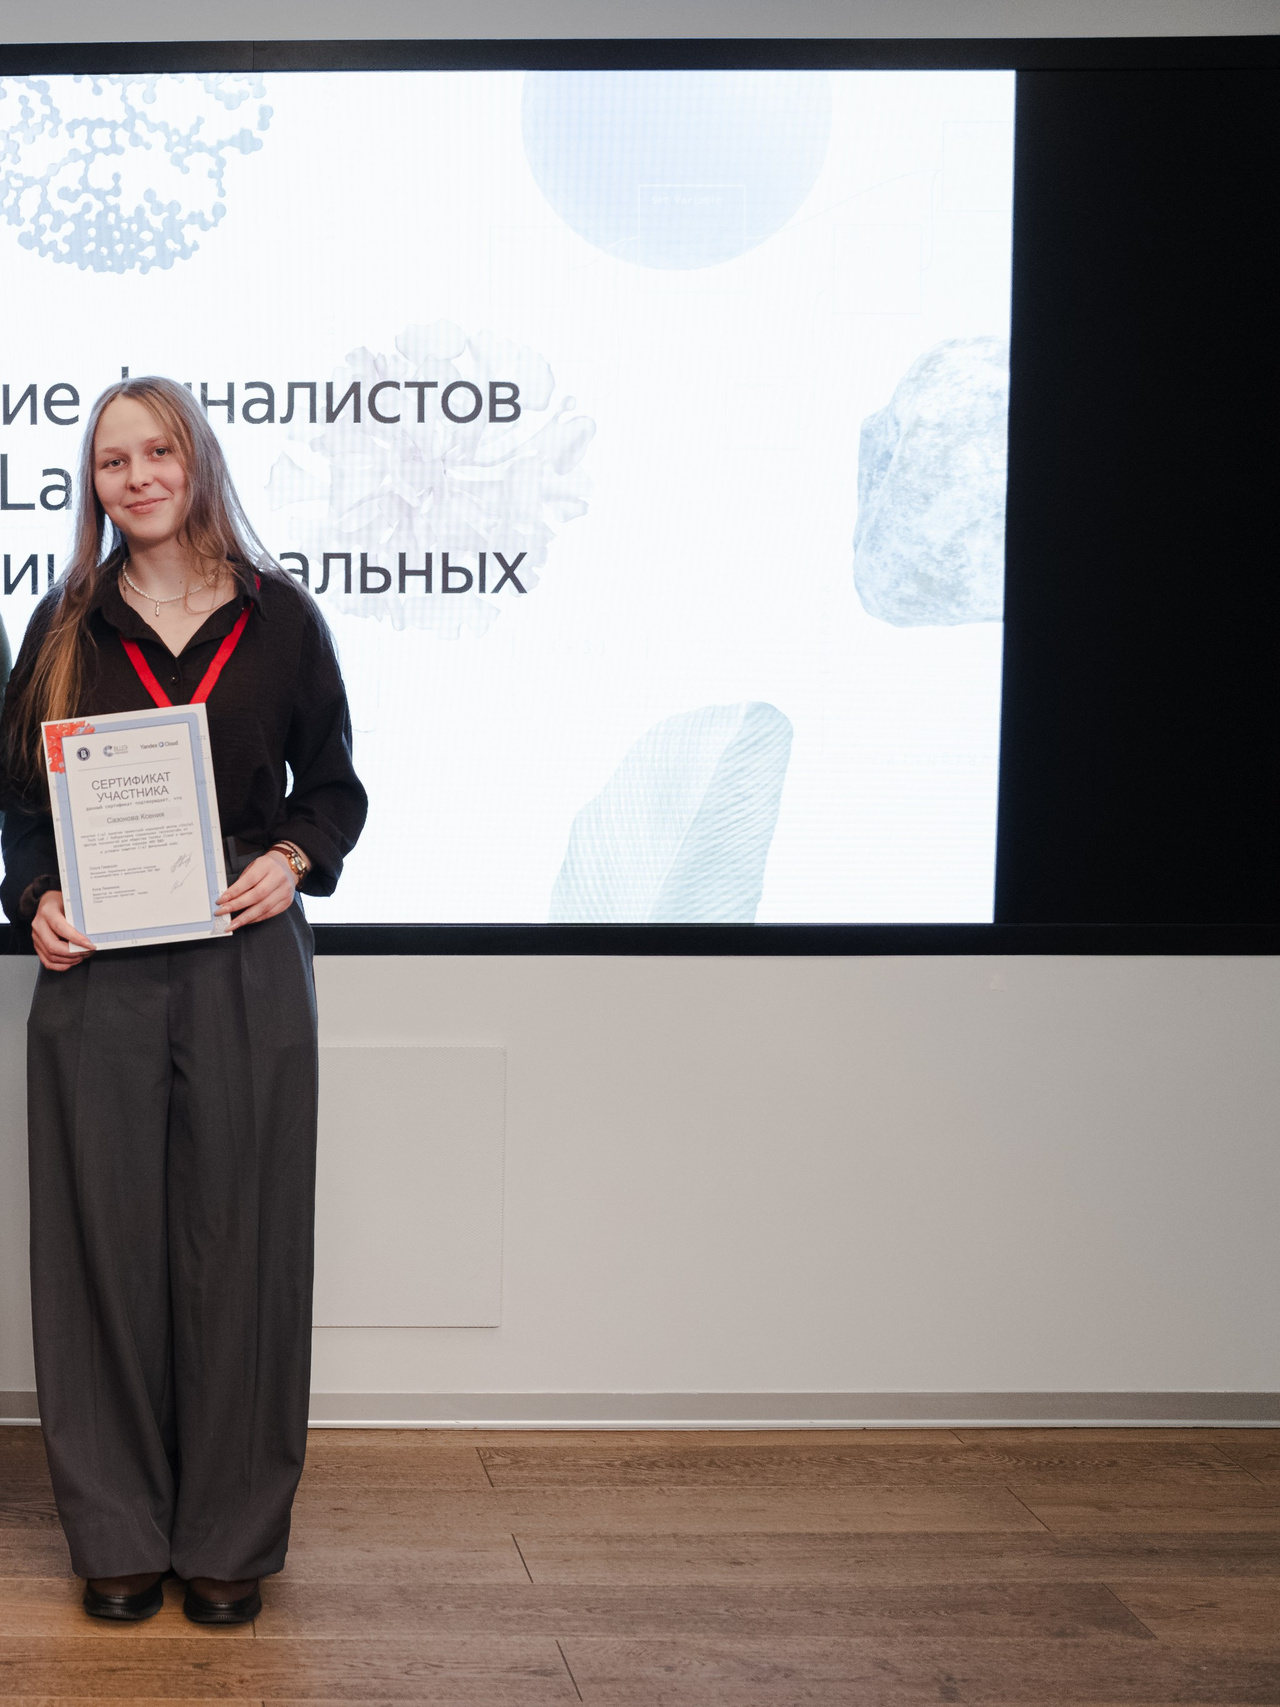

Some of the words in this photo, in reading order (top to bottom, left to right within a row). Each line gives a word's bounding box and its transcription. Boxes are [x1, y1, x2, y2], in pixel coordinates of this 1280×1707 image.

[122, 366, 522, 425] налистов
[0, 453, 73, 511] La
[278, 552, 529, 595] альных
[91, 772, 172, 791] СЕРТИФИКАТ
[96, 785, 169, 803] УЧАСТНИКА
[107, 814, 139, 824] Сазонова
